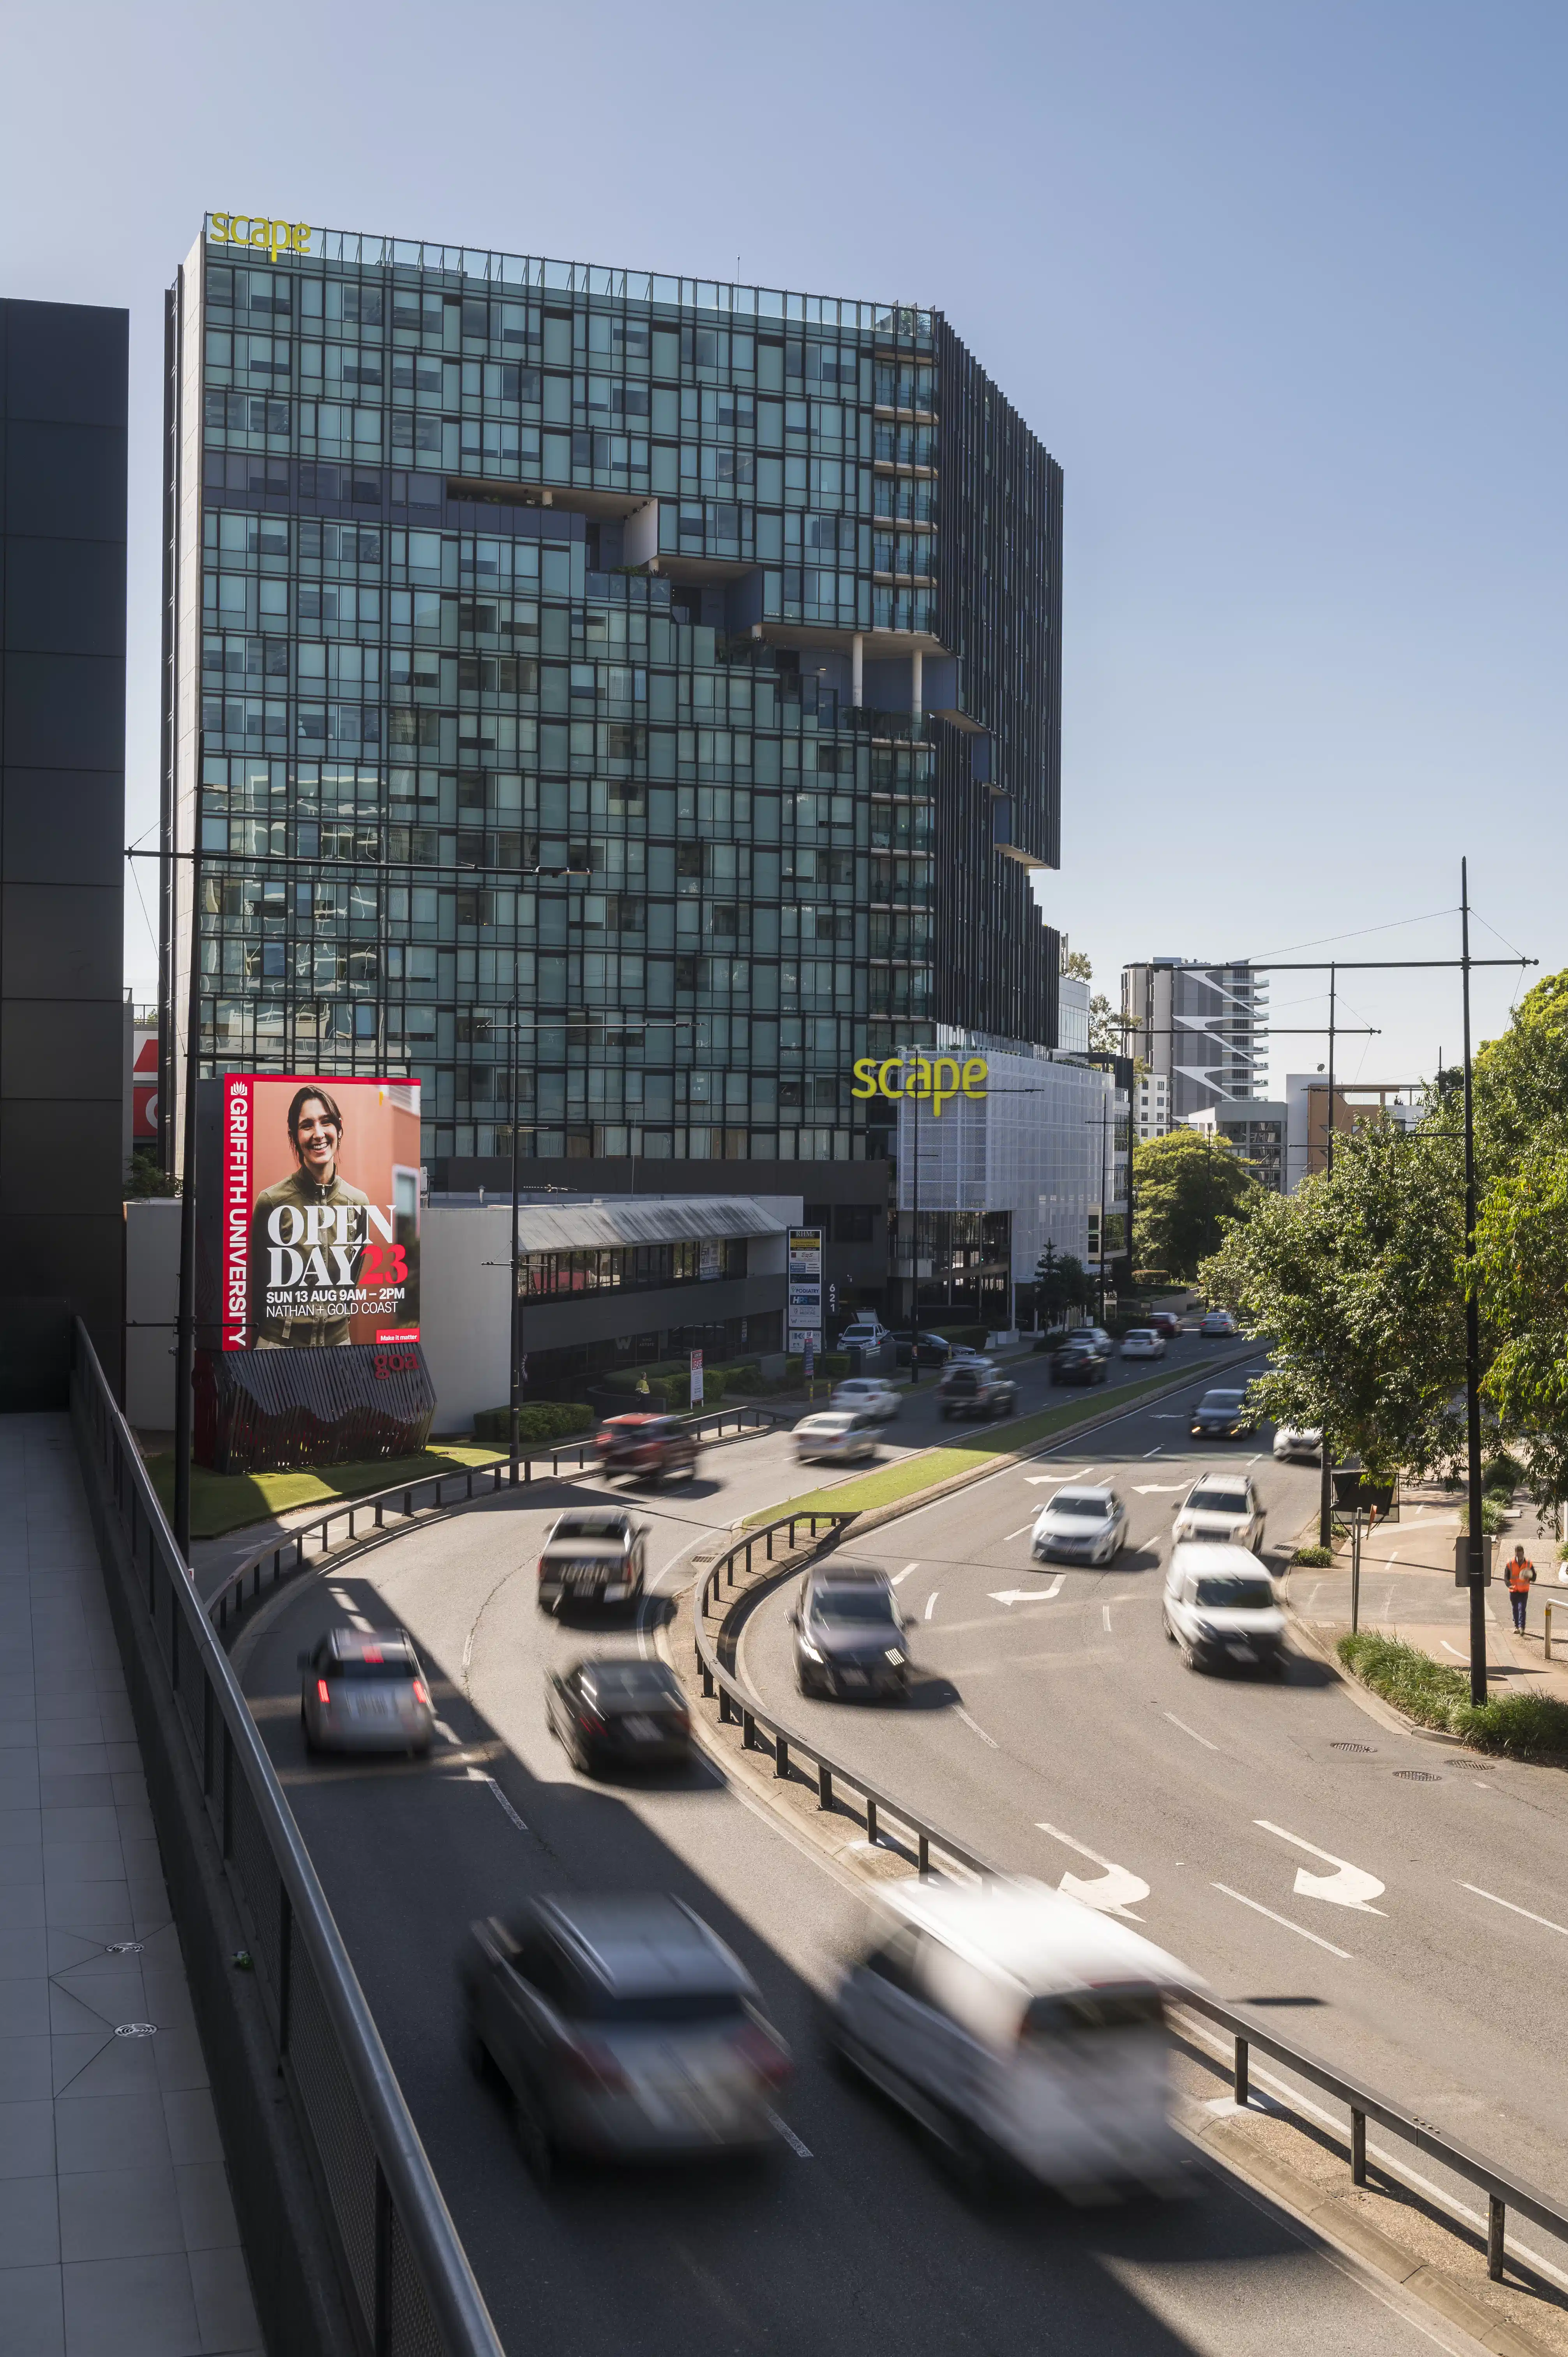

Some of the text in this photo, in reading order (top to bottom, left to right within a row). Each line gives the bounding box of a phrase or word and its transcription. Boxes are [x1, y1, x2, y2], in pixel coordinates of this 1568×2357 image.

[210, 212, 311, 262] scape
[851, 1058, 989, 1117] scape
[230, 1098, 247, 1203] GRIFFITH
[268, 1205, 397, 1246] OPEN
[267, 1292, 292, 1303] SUN
[295, 1291, 308, 1302] 13
[310, 1290, 337, 1302] AUG
[339, 1289, 366, 1301] 9AM
[379, 1288, 405, 1299] 2PM
[267, 1301, 399, 1317] NATHAN + GOLD COAST
[374, 1353, 420, 1380] goa
[692, 1360, 702, 1370] LEASE
